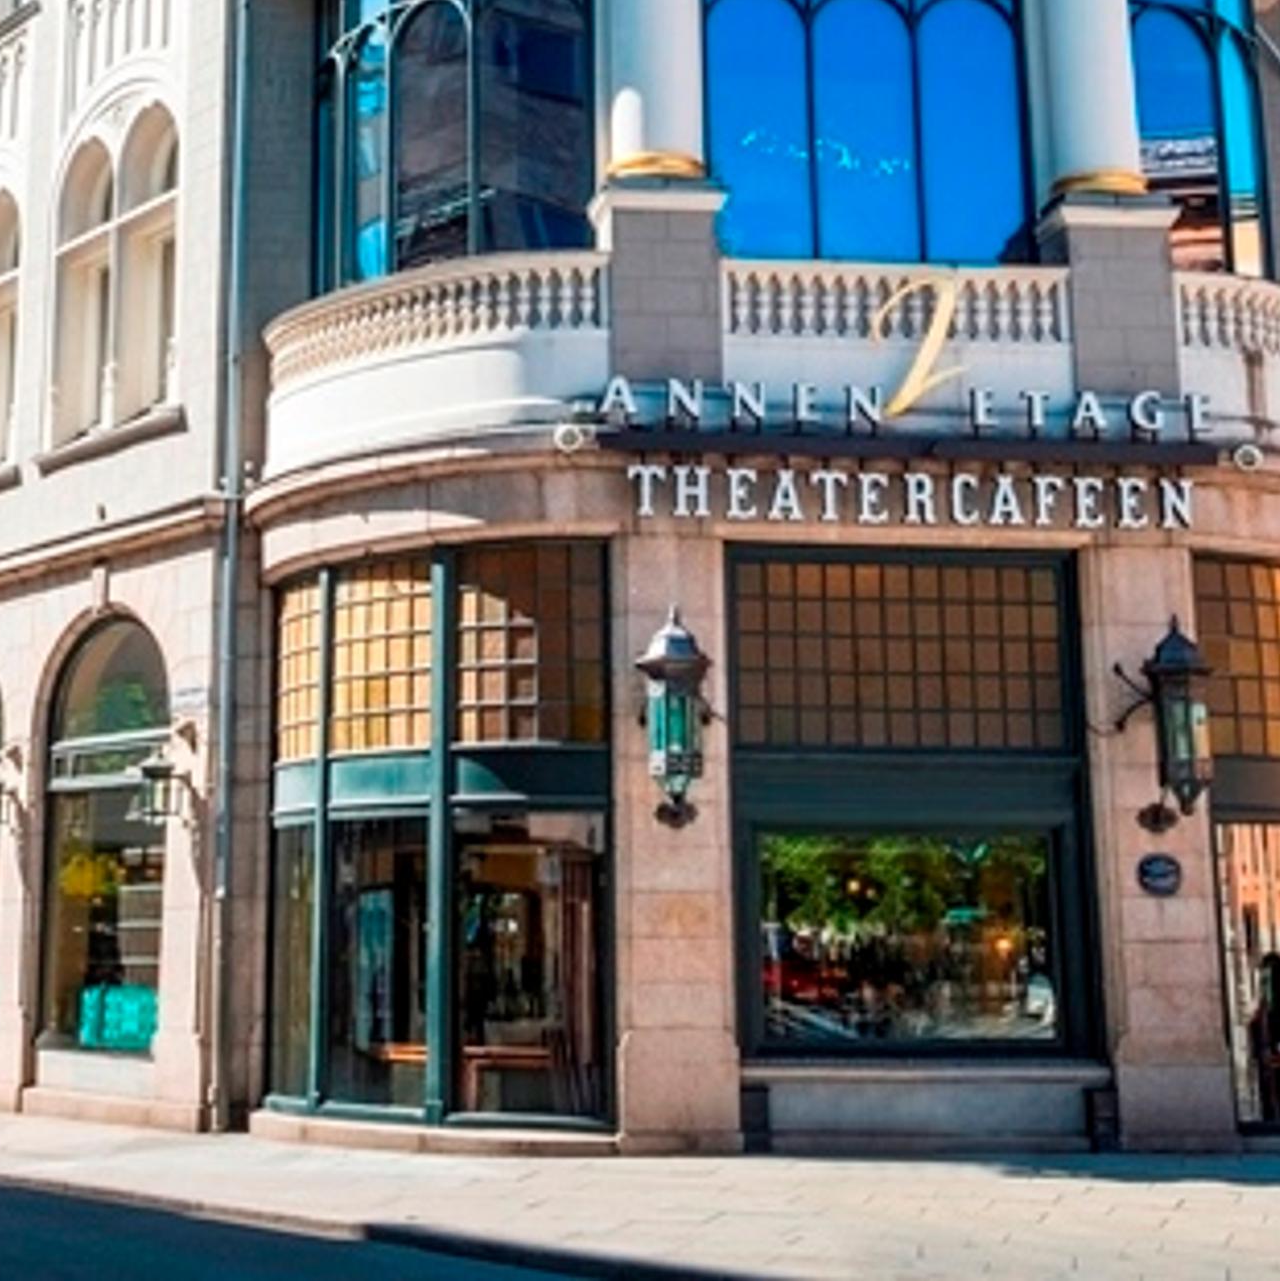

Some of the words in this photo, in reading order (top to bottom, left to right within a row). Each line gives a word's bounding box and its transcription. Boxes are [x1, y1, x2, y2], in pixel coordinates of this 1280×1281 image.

[599, 374, 882, 422] ANNEN
[975, 389, 1212, 433] ETAGE
[627, 464, 1195, 529] THEATERCAFEEN
